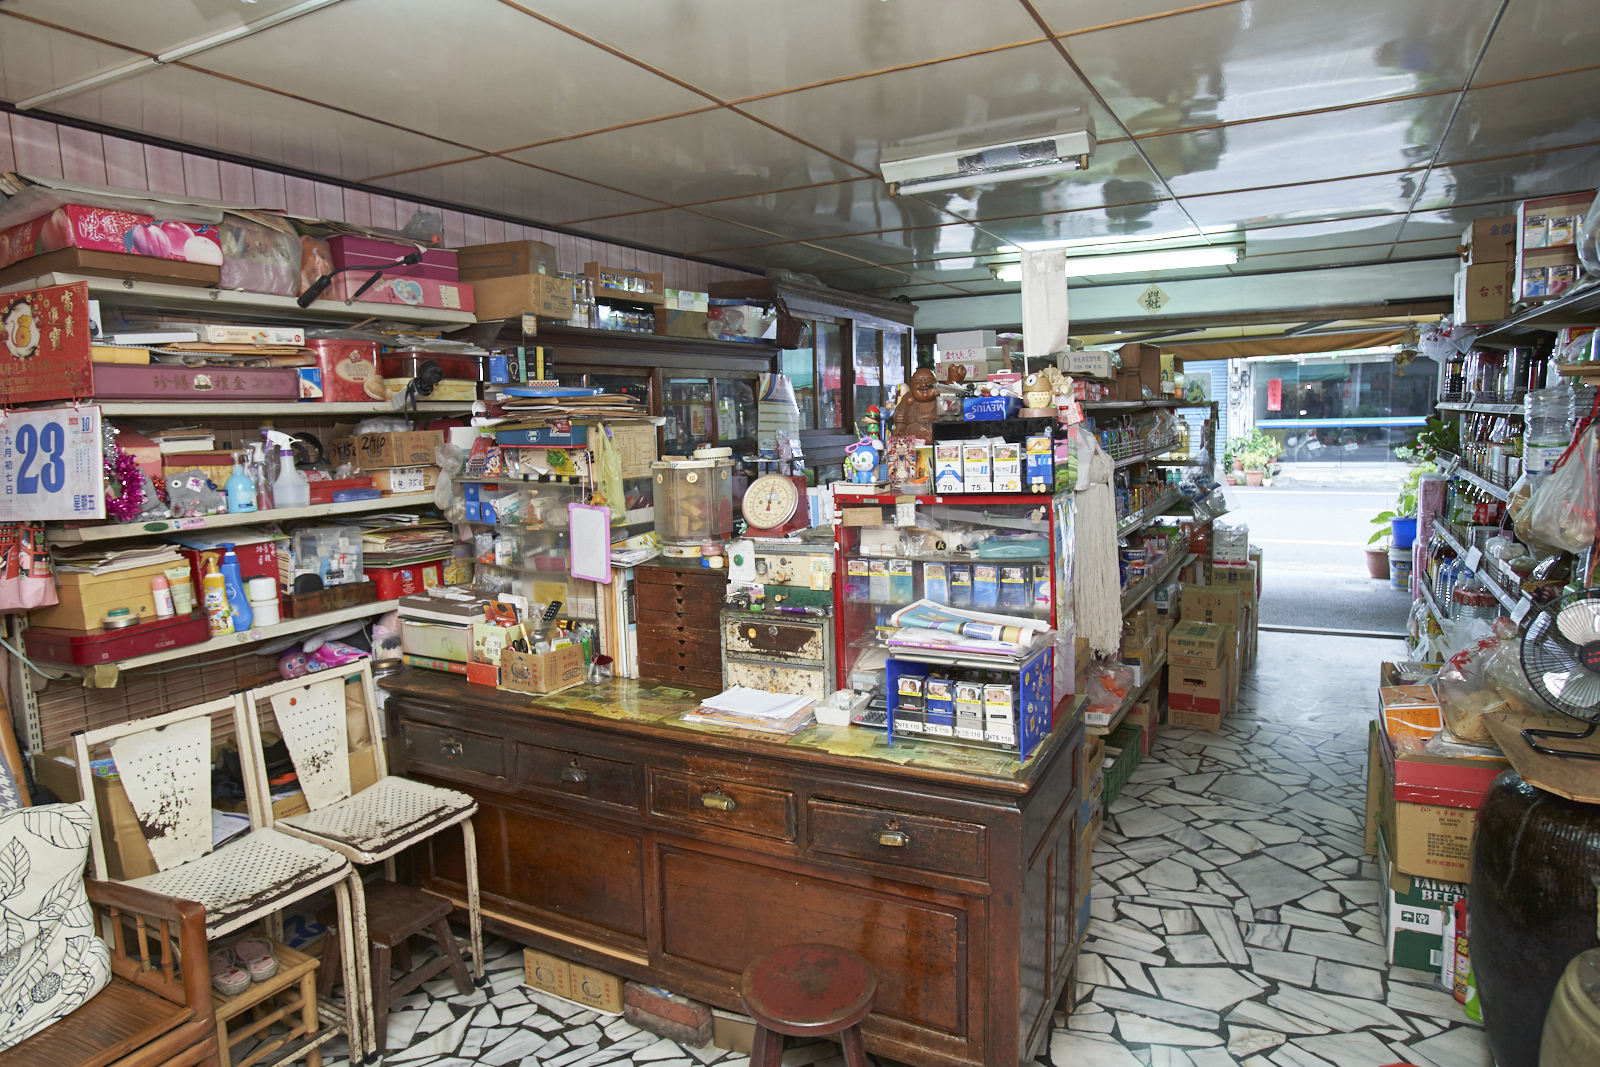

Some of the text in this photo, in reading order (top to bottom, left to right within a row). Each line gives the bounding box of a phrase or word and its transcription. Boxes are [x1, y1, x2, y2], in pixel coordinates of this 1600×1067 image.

[971, 404, 1004, 413] MEVIUS
[81, 416, 90, 432] 10
[4, 436, 13, 495] 九月初七日
[15, 421, 66, 495] 23
[1412, 876, 1467, 894] TAIWAN
